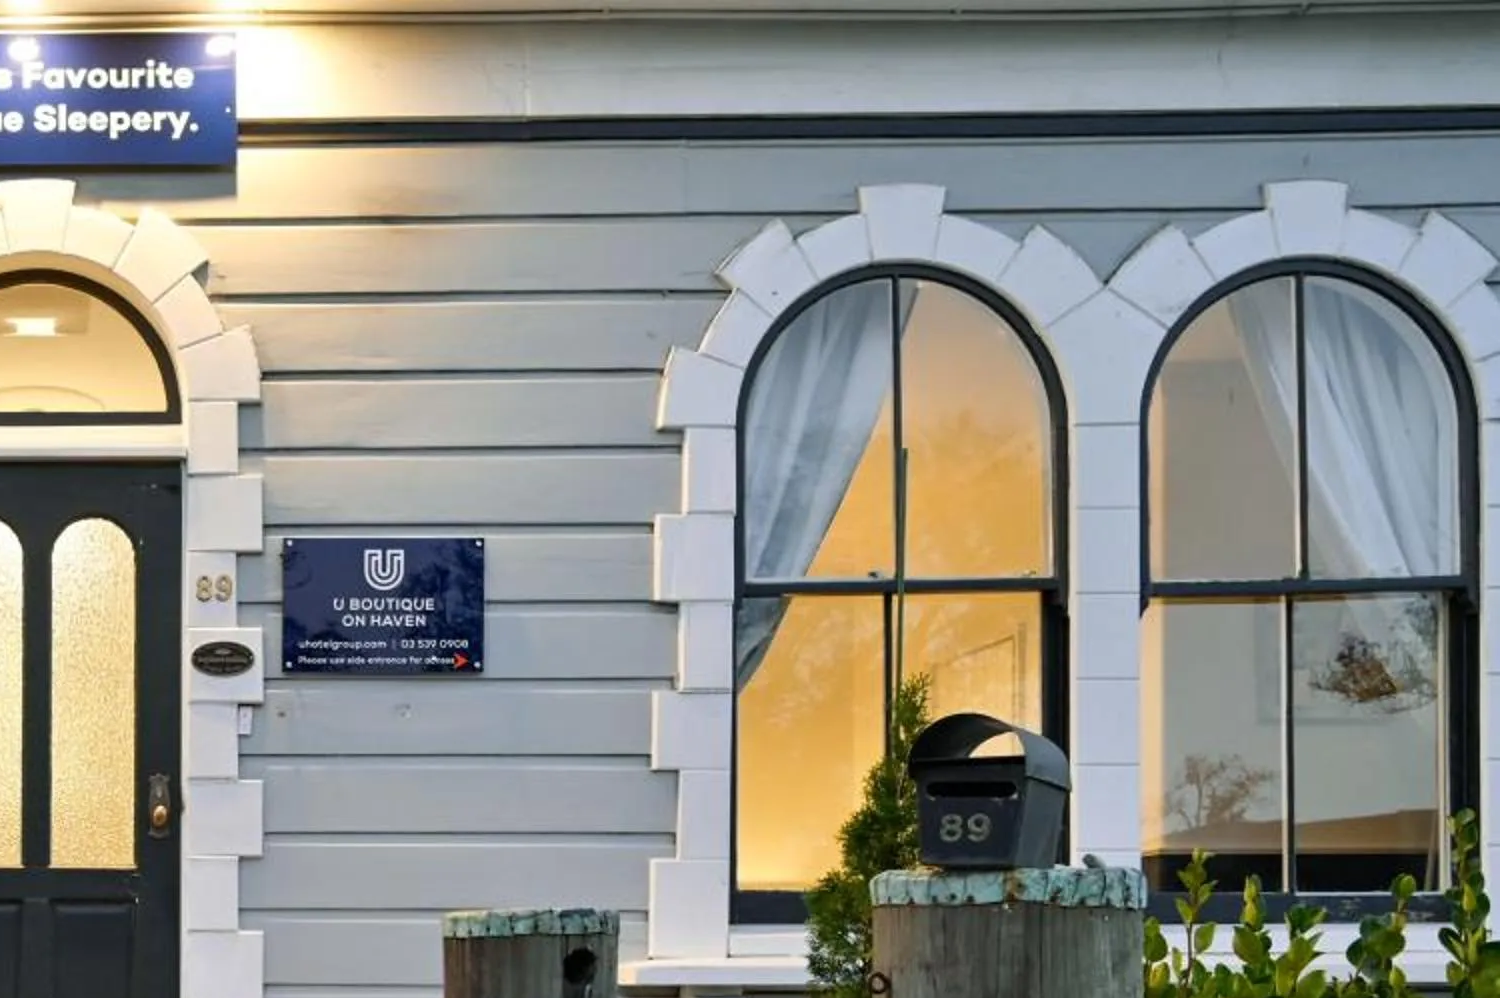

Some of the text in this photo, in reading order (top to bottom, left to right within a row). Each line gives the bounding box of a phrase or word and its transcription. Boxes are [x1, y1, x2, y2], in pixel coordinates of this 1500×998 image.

[22, 59, 195, 90] Favourite
[33, 103, 200, 140] Sleepery.
[196, 574, 233, 602] 89
[333, 597, 435, 611] U BOUTIQUE
[341, 614, 428, 628] ON HAVEN
[401, 639, 415, 649] 03
[939, 813, 992, 842] 89
